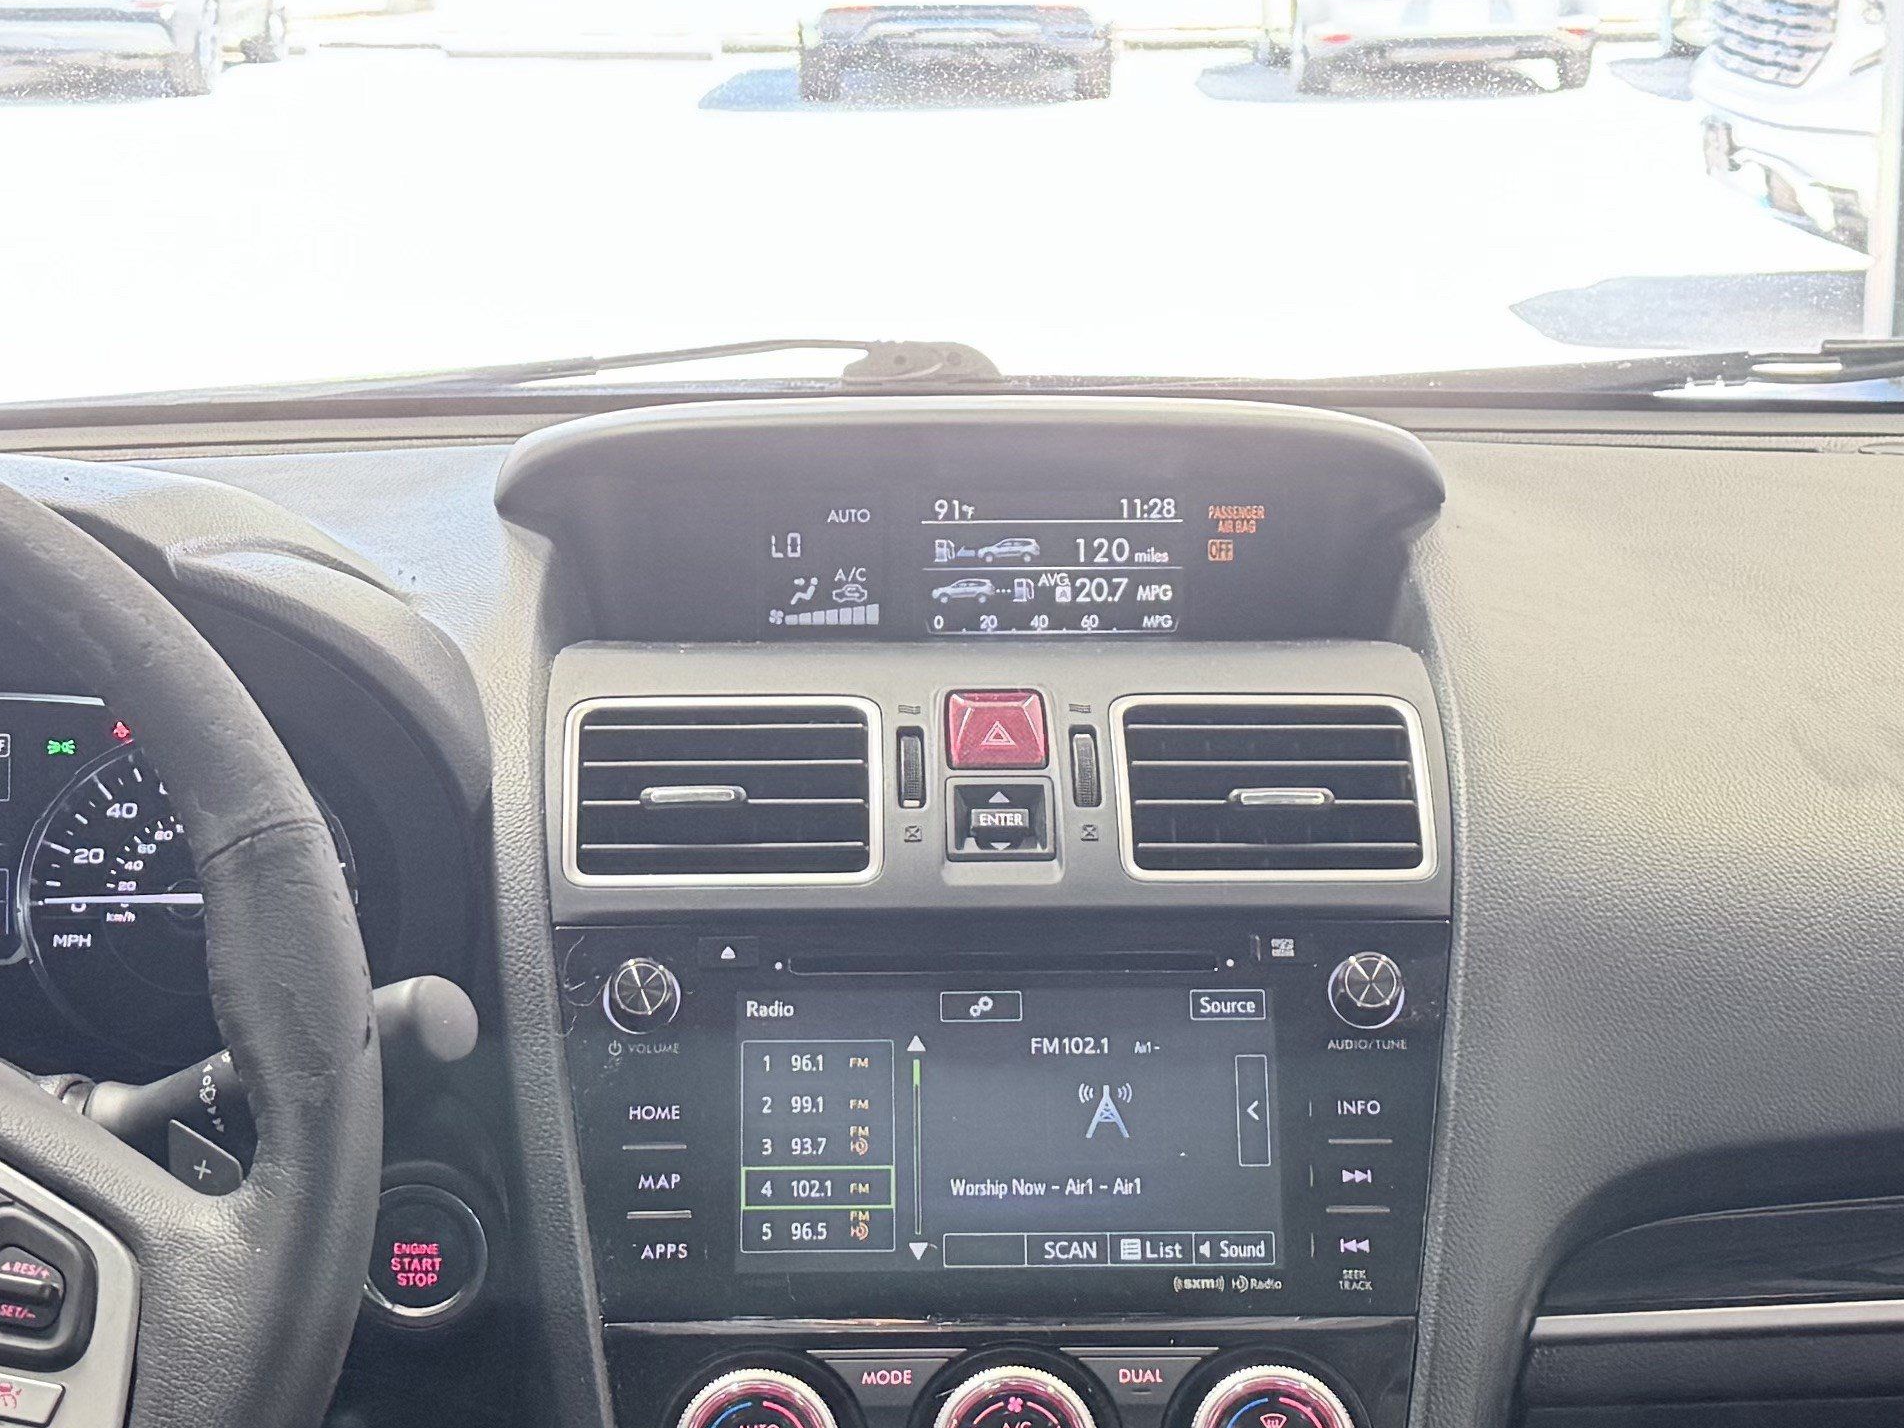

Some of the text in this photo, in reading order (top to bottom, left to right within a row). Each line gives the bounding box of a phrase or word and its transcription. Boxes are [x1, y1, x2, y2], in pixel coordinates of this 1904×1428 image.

[826, 508, 871, 523] AUTO
[1120, 498, 1176, 520] 11:28
[1208, 504, 1266, 519] PASSENGER
[1217, 521, 1257, 534] AIR BAG
[1076, 538, 1169, 564] 120 miles
[1208, 540, 1234, 560] OFF
[834, 566, 867, 582] A/C
[1038, 573, 1069, 587] AVG
[1075, 578, 1173, 603] 20.7 MPG
[933, 614, 1173, 630] 0 20 40 60 MPG
[106, 802, 138, 819] 40
[979, 813, 1024, 826] ENTER
[73, 848, 105, 864] 20
[124, 860, 144, 871] 40
[106, 912, 136, 923] km/h
[52, 933, 92, 948] MPH
[746, 1001, 794, 1018] Radio
[1199, 997, 1256, 1015] Source
[627, 1043, 681, 1055] VOLUME
[1327, 1038, 1408, 1052] AUDIO/TUNE
[763, 1055, 870, 1072] 1 96.1 FM
[628, 1105, 681, 1120] HOME
[761, 1097, 870, 1113] 2 99.1 FM
[1337, 1099, 1381, 1115] INFO
[761, 1125, 870, 1155] 3 93.7 FM
[638, 1174, 681, 1190] MAP
[760, 1179, 870, 1197] 4 102.1 FM
[950, 1177, 1008, 1198] Worship
[1011, 1178, 1047, 1195] Now
[761, 1210, 870, 1240] 5 96.5 FM
[393, 1242, 440, 1255] ENGINE
[640, 1244, 689, 1260] APPS
[1044, 1240, 1097, 1259] SCAN
[1145, 1240, 1183, 1259] List
[1220, 1239, 1266, 1258] Sound
[390, 1257, 443, 1271] START
[396, 1272, 438, 1287] STOP
[1342, 1270, 1367, 1280] SEEK
[1250, 1278, 1282, 1290] Radio
[1338, 1280, 1373, 1291] TRACK
[861, 1369, 913, 1386] MODE
[1118, 1368, 1164, 1384] DUAL
